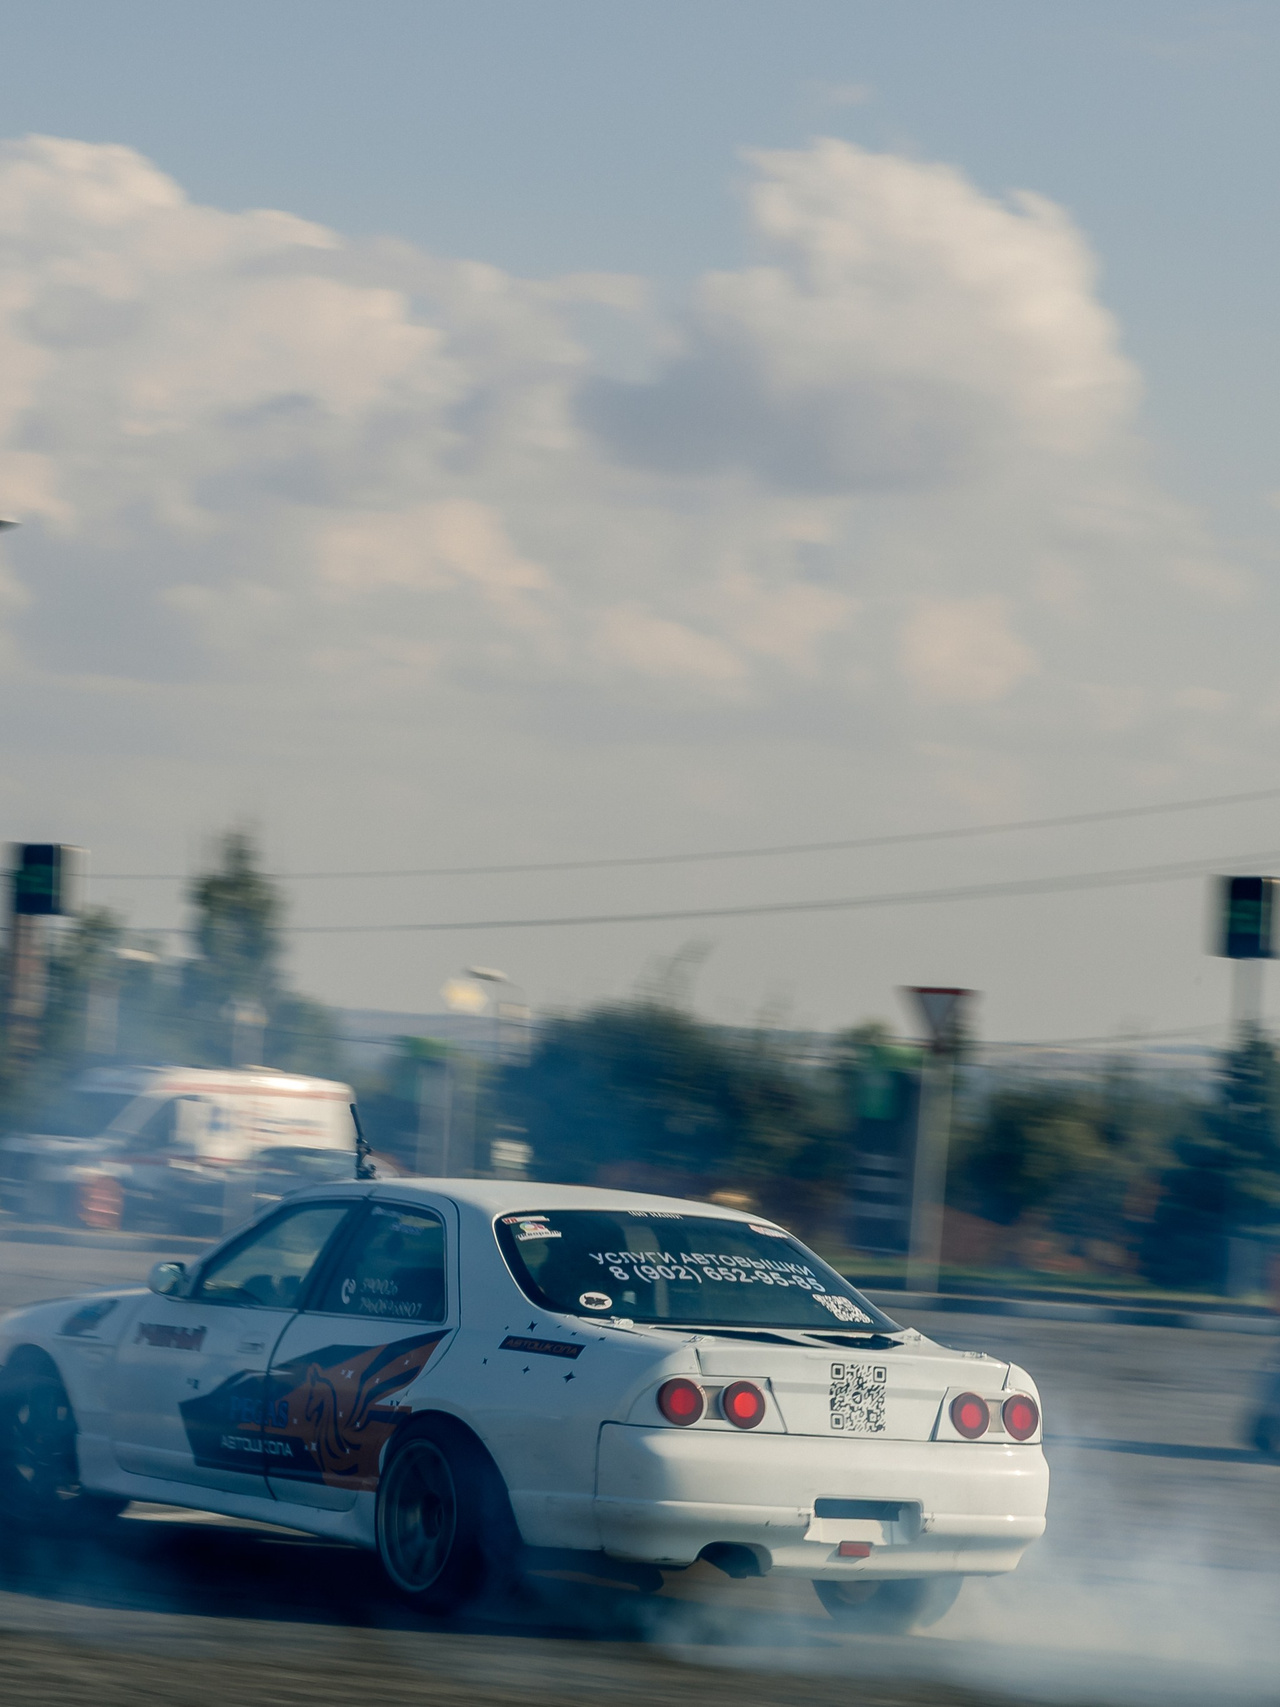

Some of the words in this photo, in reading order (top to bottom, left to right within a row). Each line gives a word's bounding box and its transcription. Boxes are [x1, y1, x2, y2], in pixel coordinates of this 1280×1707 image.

[589, 1252, 677, 1265] УСЛУГИ
[679, 1252, 816, 1278] АВТОВЫШКИ
[609, 1265, 630, 1281] 8
[633, 1264, 703, 1284] (902)
[702, 1266, 827, 1293] 652-95-85
[505, 1338, 578, 1355] АВТОШКОЛА
[230, 1396, 289, 1429] PEGAS
